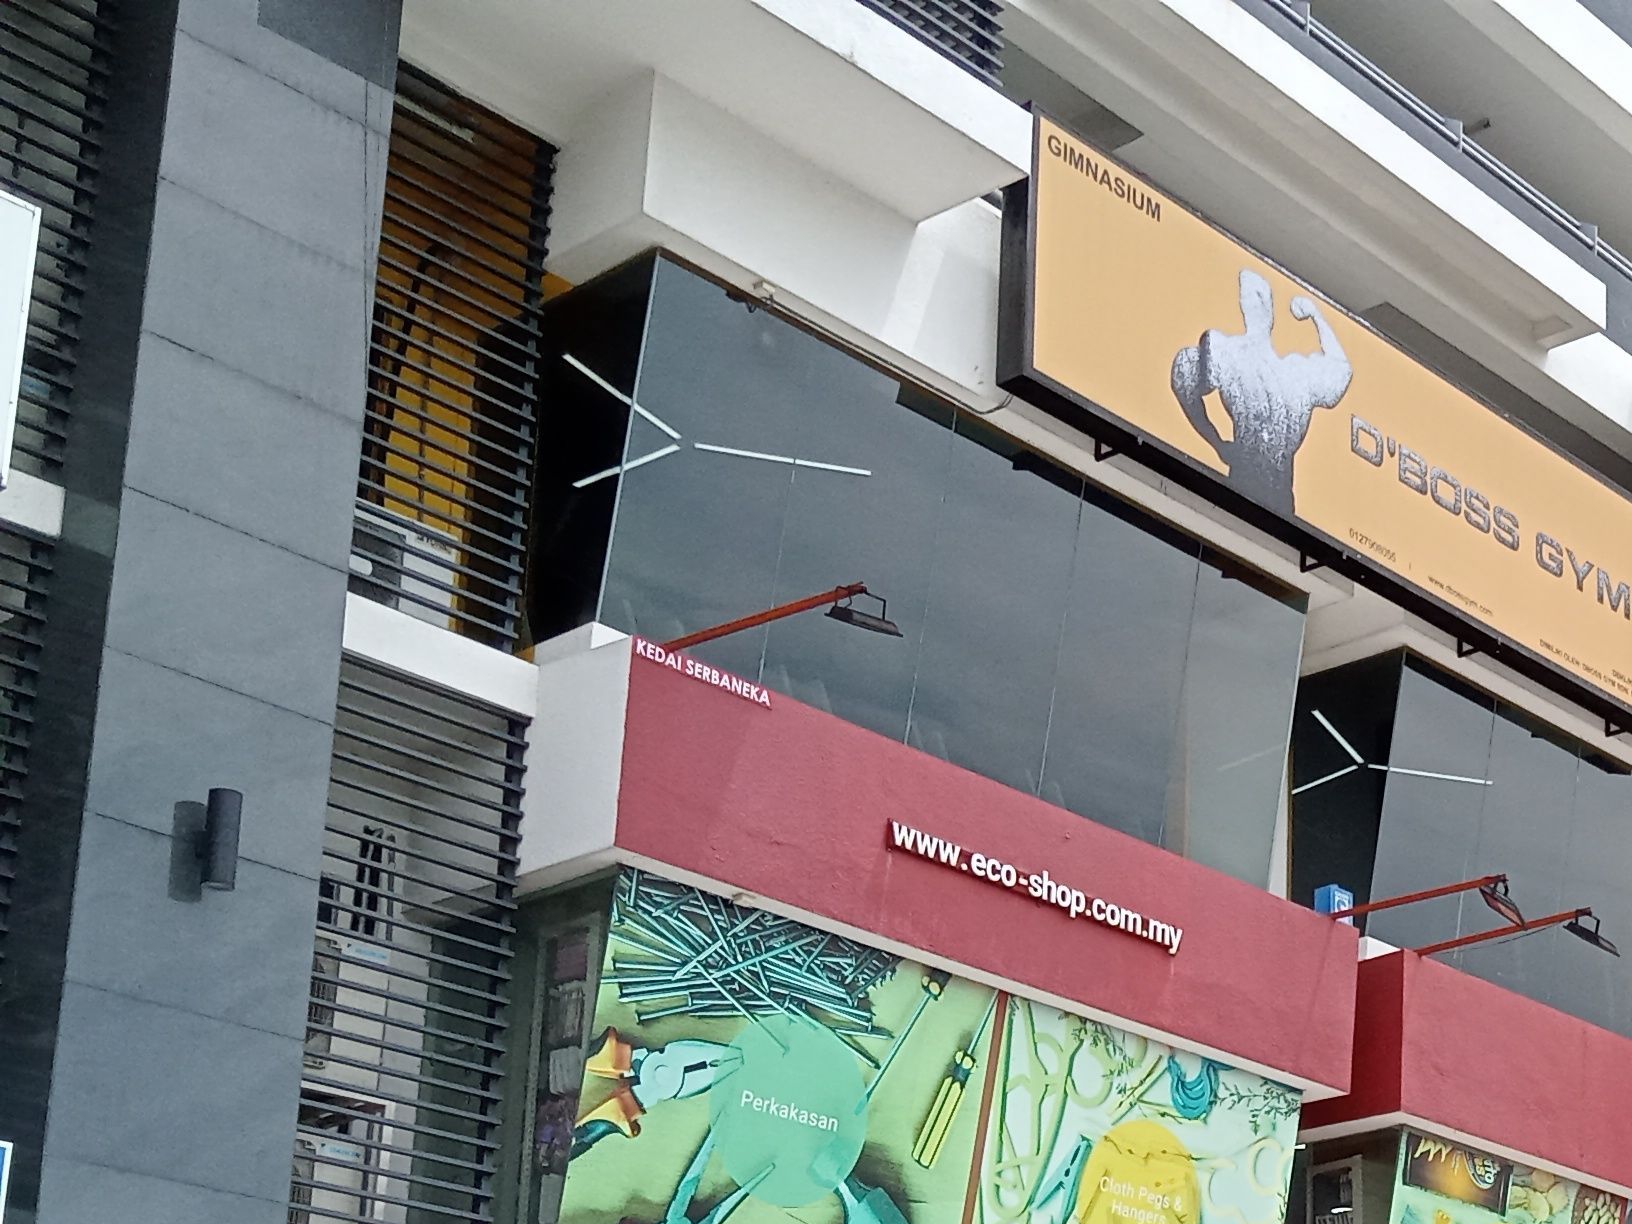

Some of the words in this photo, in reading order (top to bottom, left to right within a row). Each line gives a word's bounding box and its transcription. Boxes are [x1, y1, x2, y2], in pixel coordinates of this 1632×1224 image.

[1047, 134, 1161, 222] GIMNASIUM
[1351, 413, 1520, 551] D'BOSS
[1536, 532, 1631, 621] GYM
[636, 638, 682, 671] KEDAI
[685, 659, 771, 707] SERBANEKA
[891, 820, 1183, 954] www.eco-shop.com.my
[740, 1090, 839, 1132] Perkakasan
[1100, 1176, 1135, 1199] Cloth
[1138, 1186, 1170, 1210] Pegs
